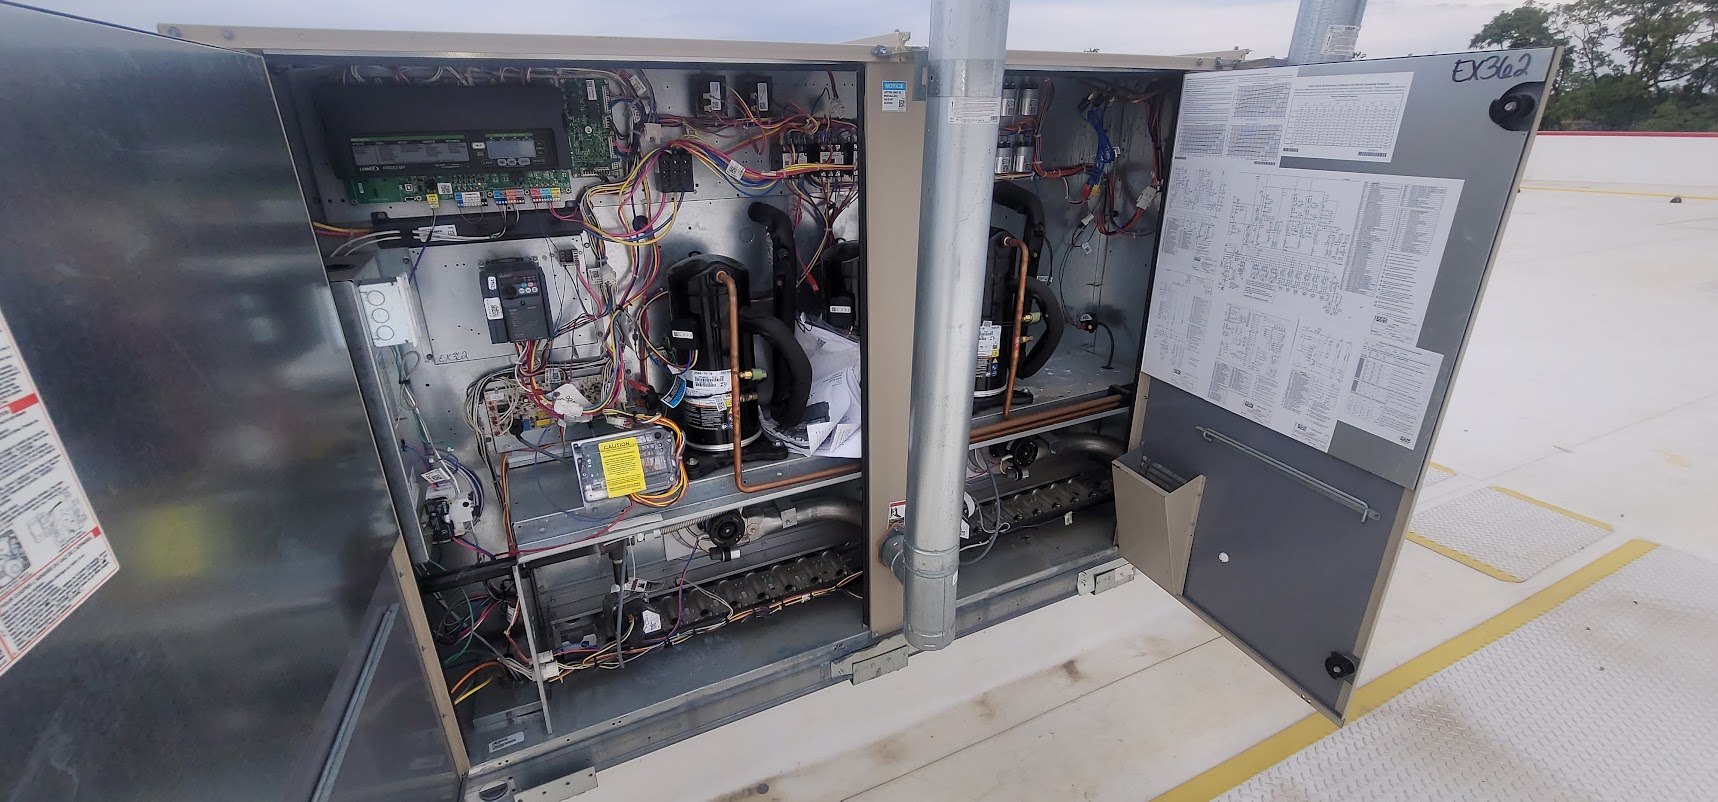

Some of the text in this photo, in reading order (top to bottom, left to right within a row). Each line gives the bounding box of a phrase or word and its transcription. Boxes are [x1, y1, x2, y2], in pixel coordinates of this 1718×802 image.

[1451, 52, 1532, 83] EX362
[884, 82, 904, 90] NOTICE
[603, 440, 630, 450] CAUTION
